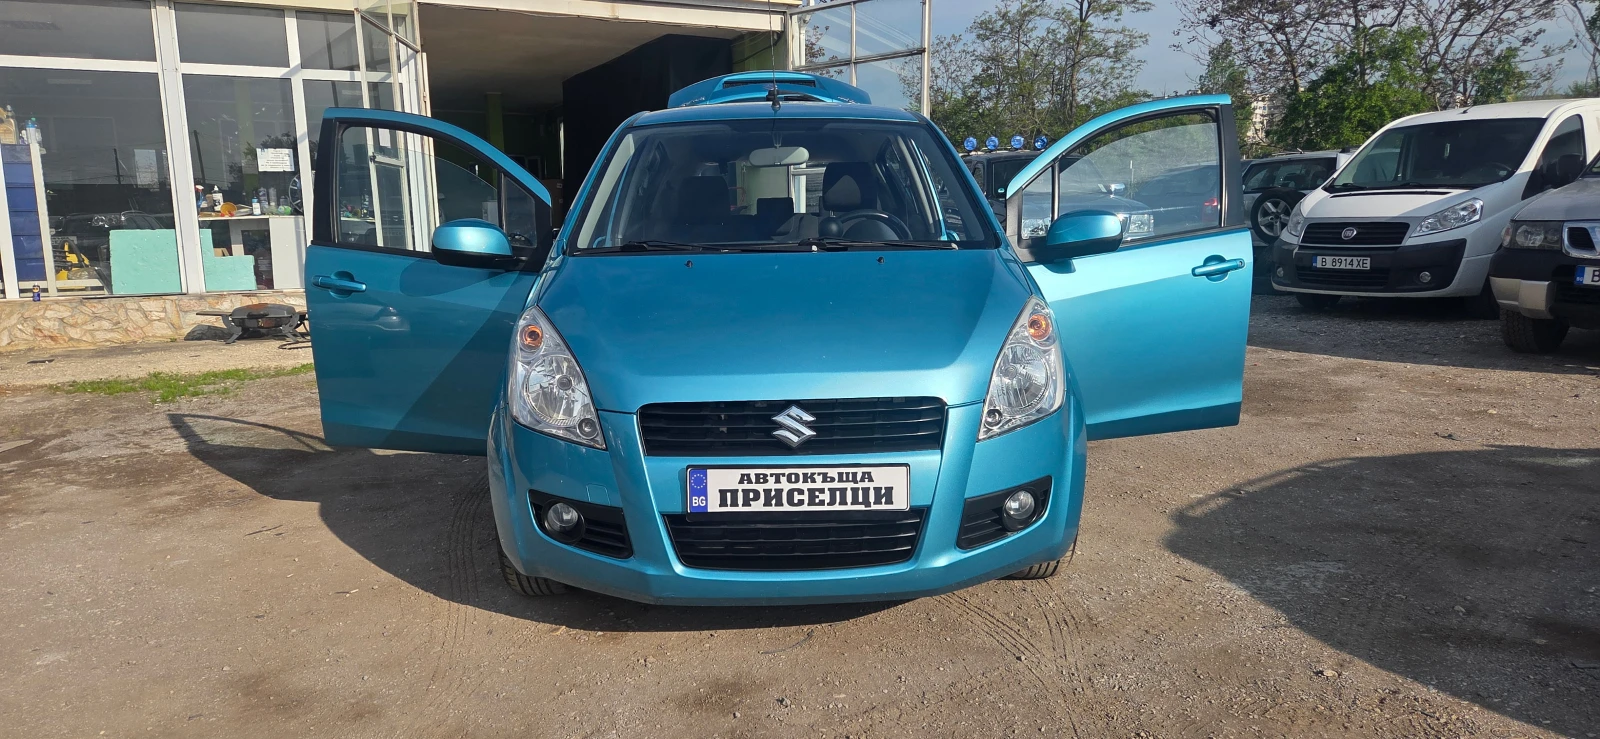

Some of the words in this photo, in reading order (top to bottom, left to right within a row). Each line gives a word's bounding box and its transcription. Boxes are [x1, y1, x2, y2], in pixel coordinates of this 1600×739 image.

[1321, 257, 1327, 267] B
[1331, 258, 1354, 267] 8914
[1356, 259, 1369, 268] XE
[737, 471, 875, 485] АВТОКЪЩА
[692, 496, 706, 507] BG
[718, 486, 894, 508] ПРИСЕЛЦИ
